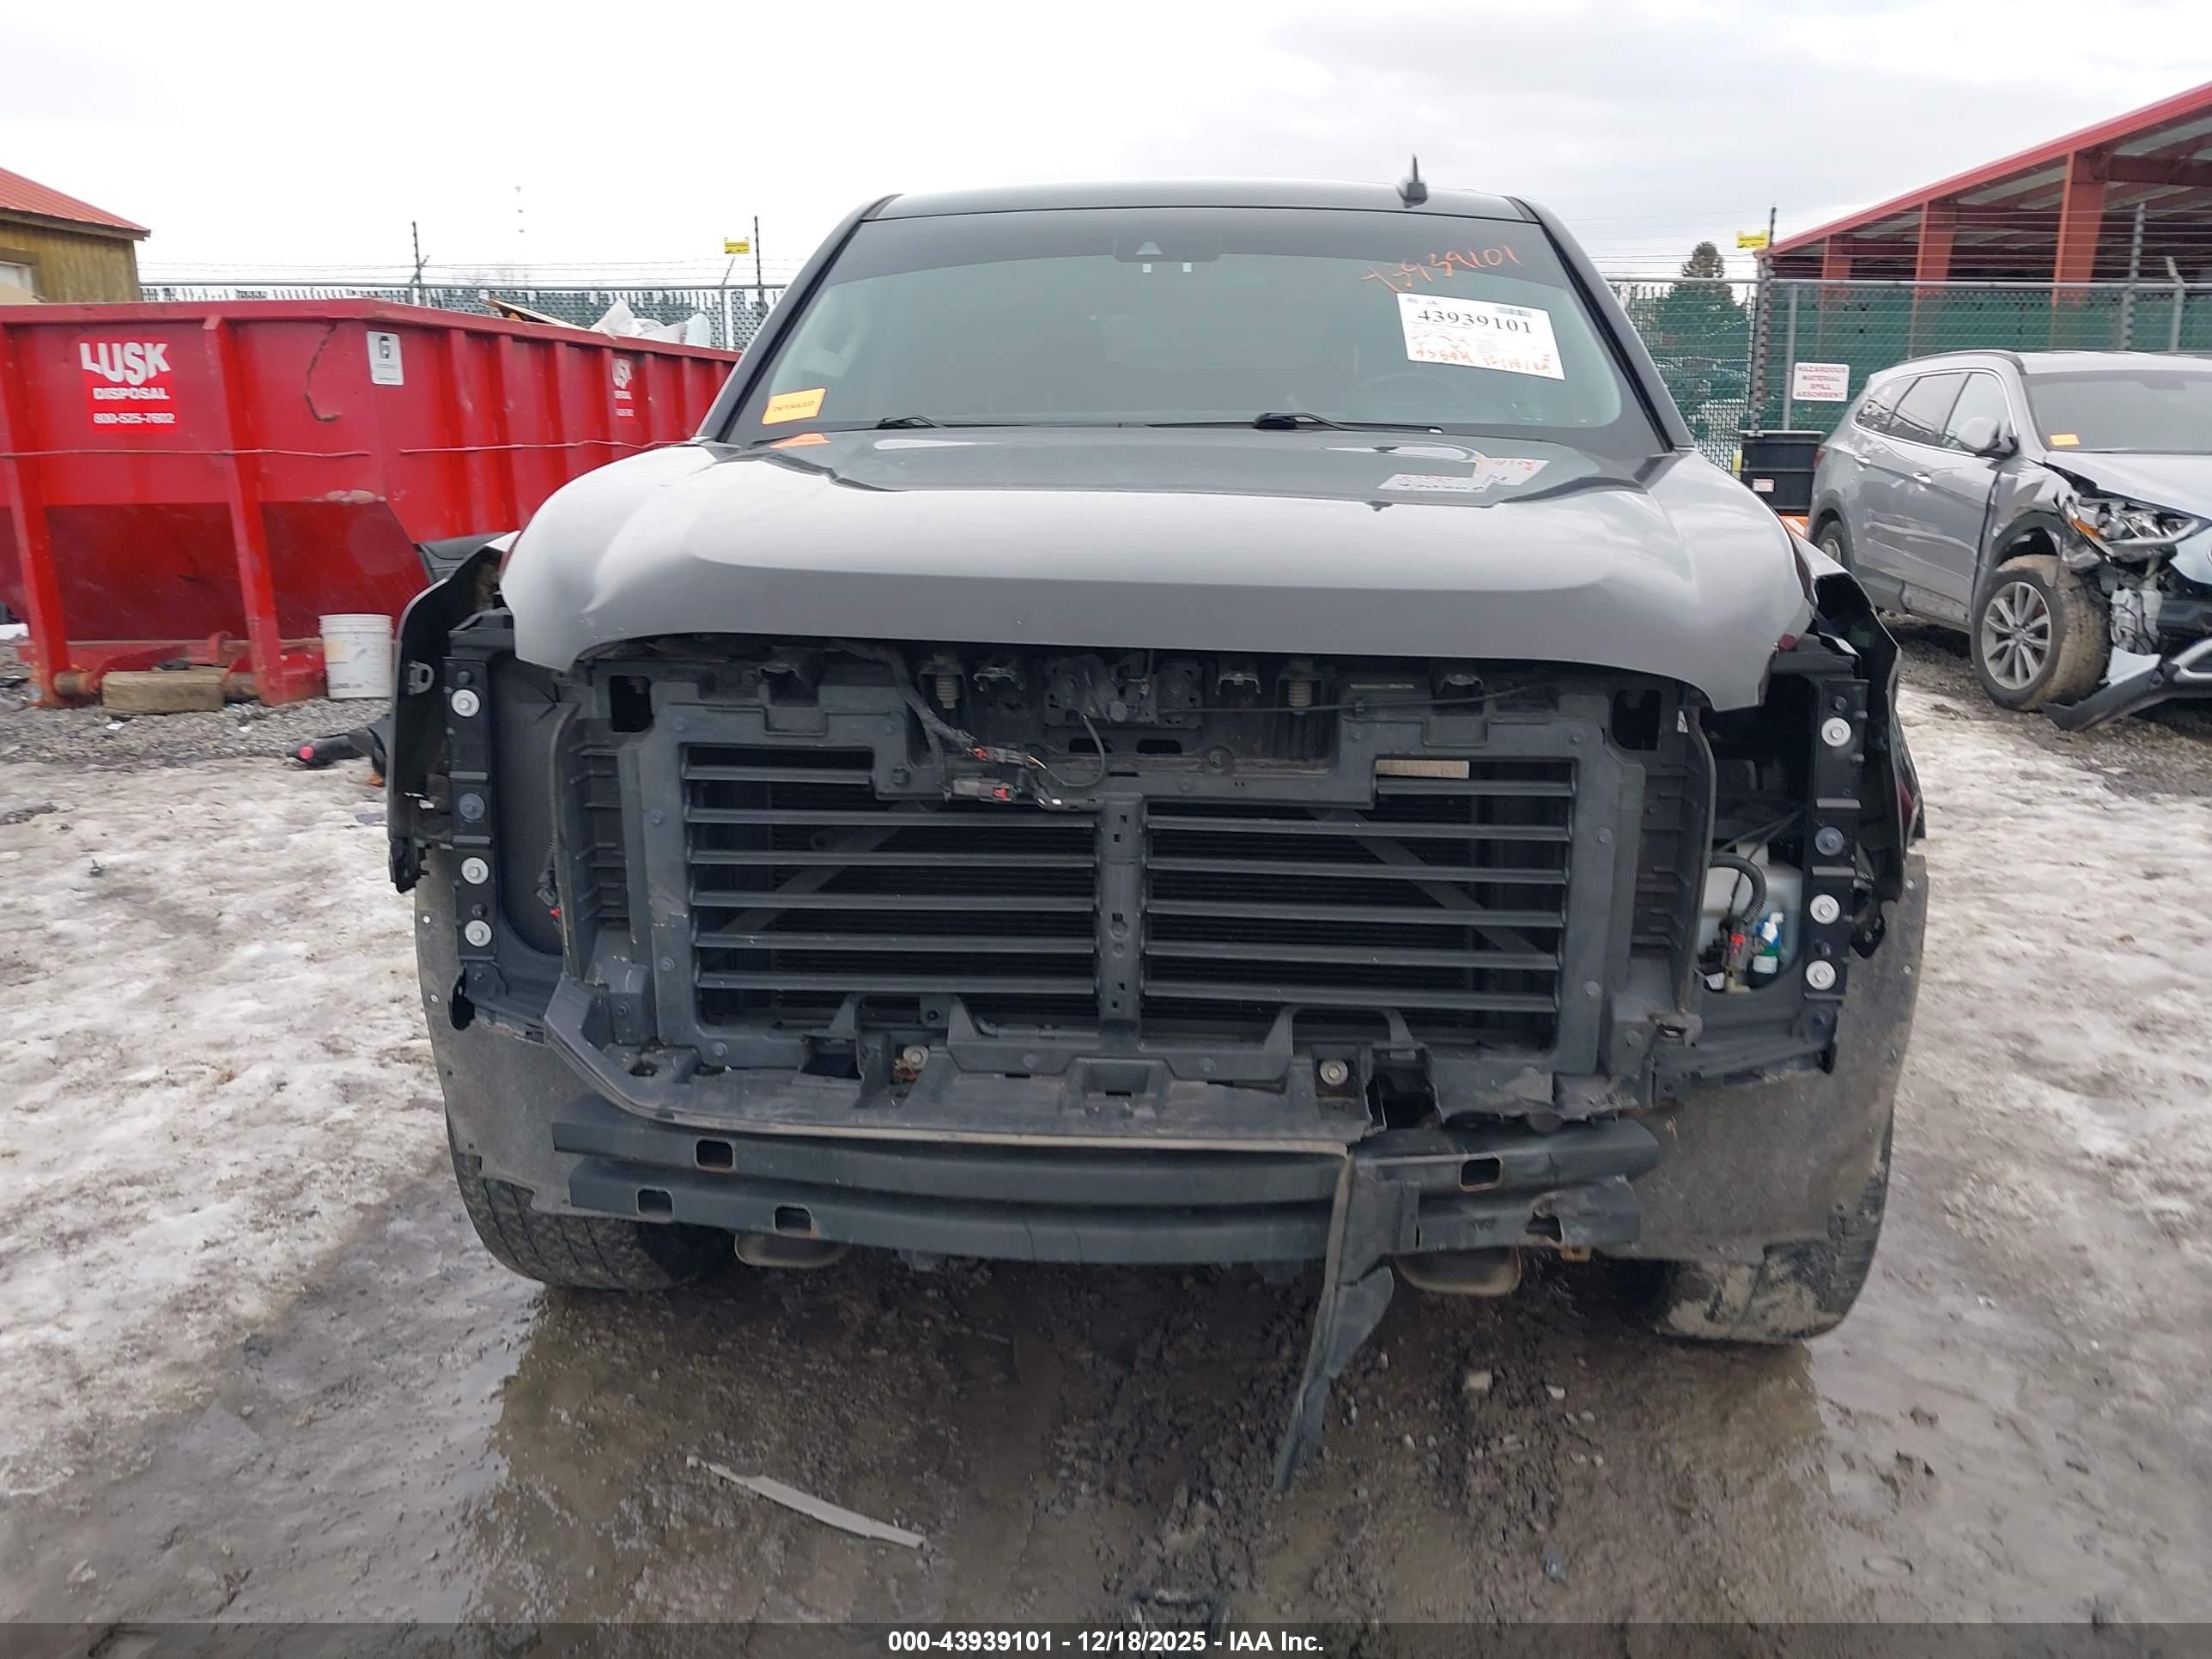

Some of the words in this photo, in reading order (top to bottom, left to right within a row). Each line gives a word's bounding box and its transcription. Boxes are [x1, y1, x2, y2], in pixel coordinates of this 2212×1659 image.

[1418, 310, 1533, 334] 43939101
[79, 342, 172, 386] LUSK
[92, 387, 171, 399] DISPOSAL
